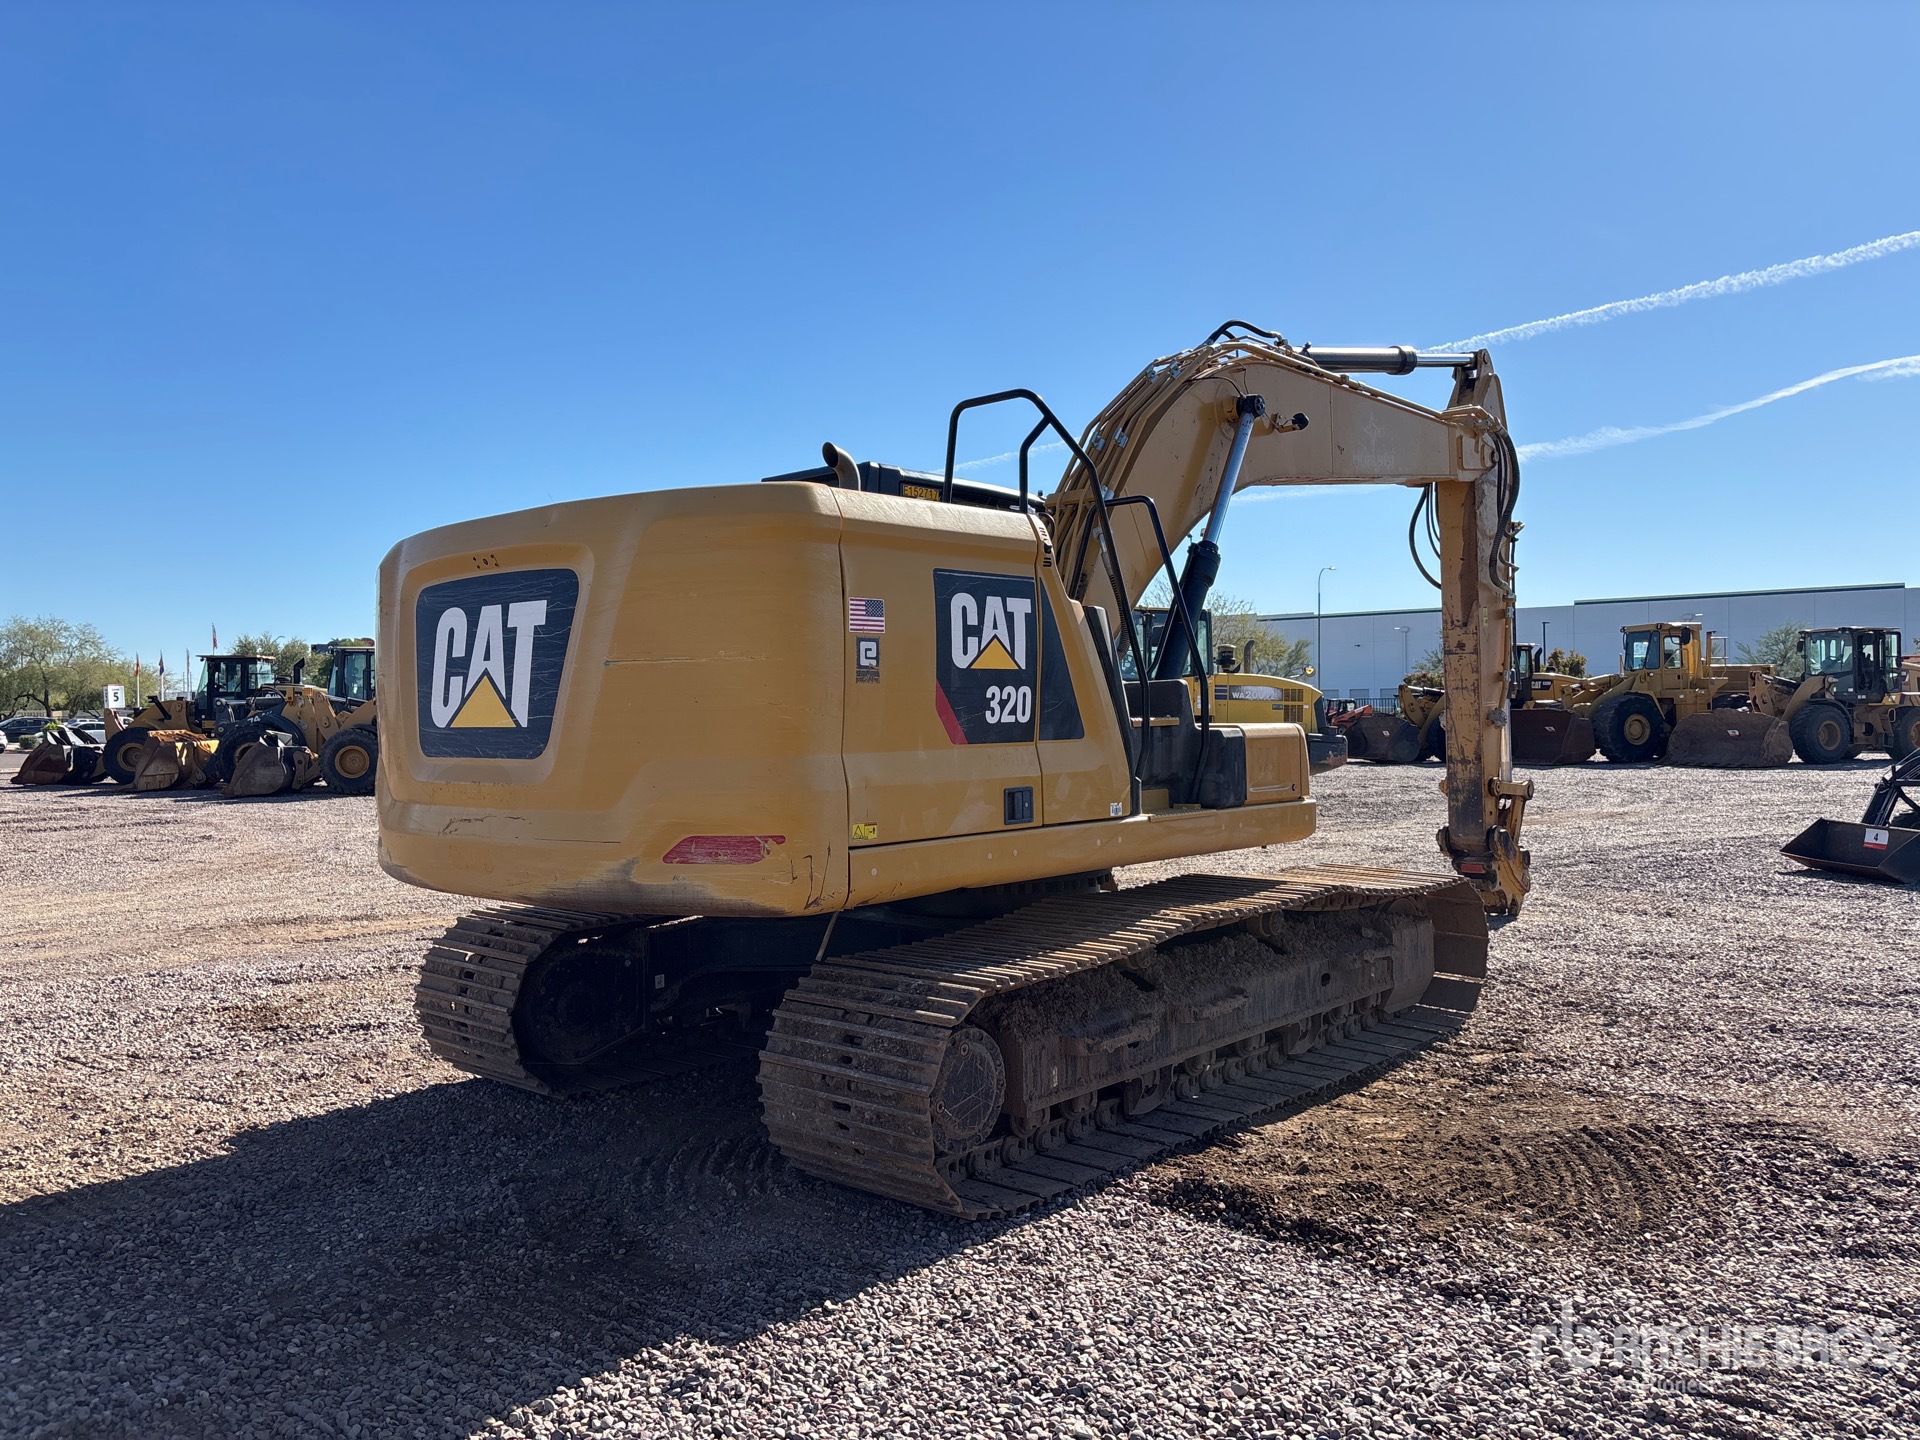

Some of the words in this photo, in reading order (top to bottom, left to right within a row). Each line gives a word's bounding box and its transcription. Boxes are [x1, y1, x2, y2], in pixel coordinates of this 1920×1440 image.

[951, 592, 1032, 670] CAT
[431, 599, 548, 728] CAT
[113, 691, 120, 702] 5
[985, 685, 1032, 724] 320
[1873, 832, 1879, 841] 4
